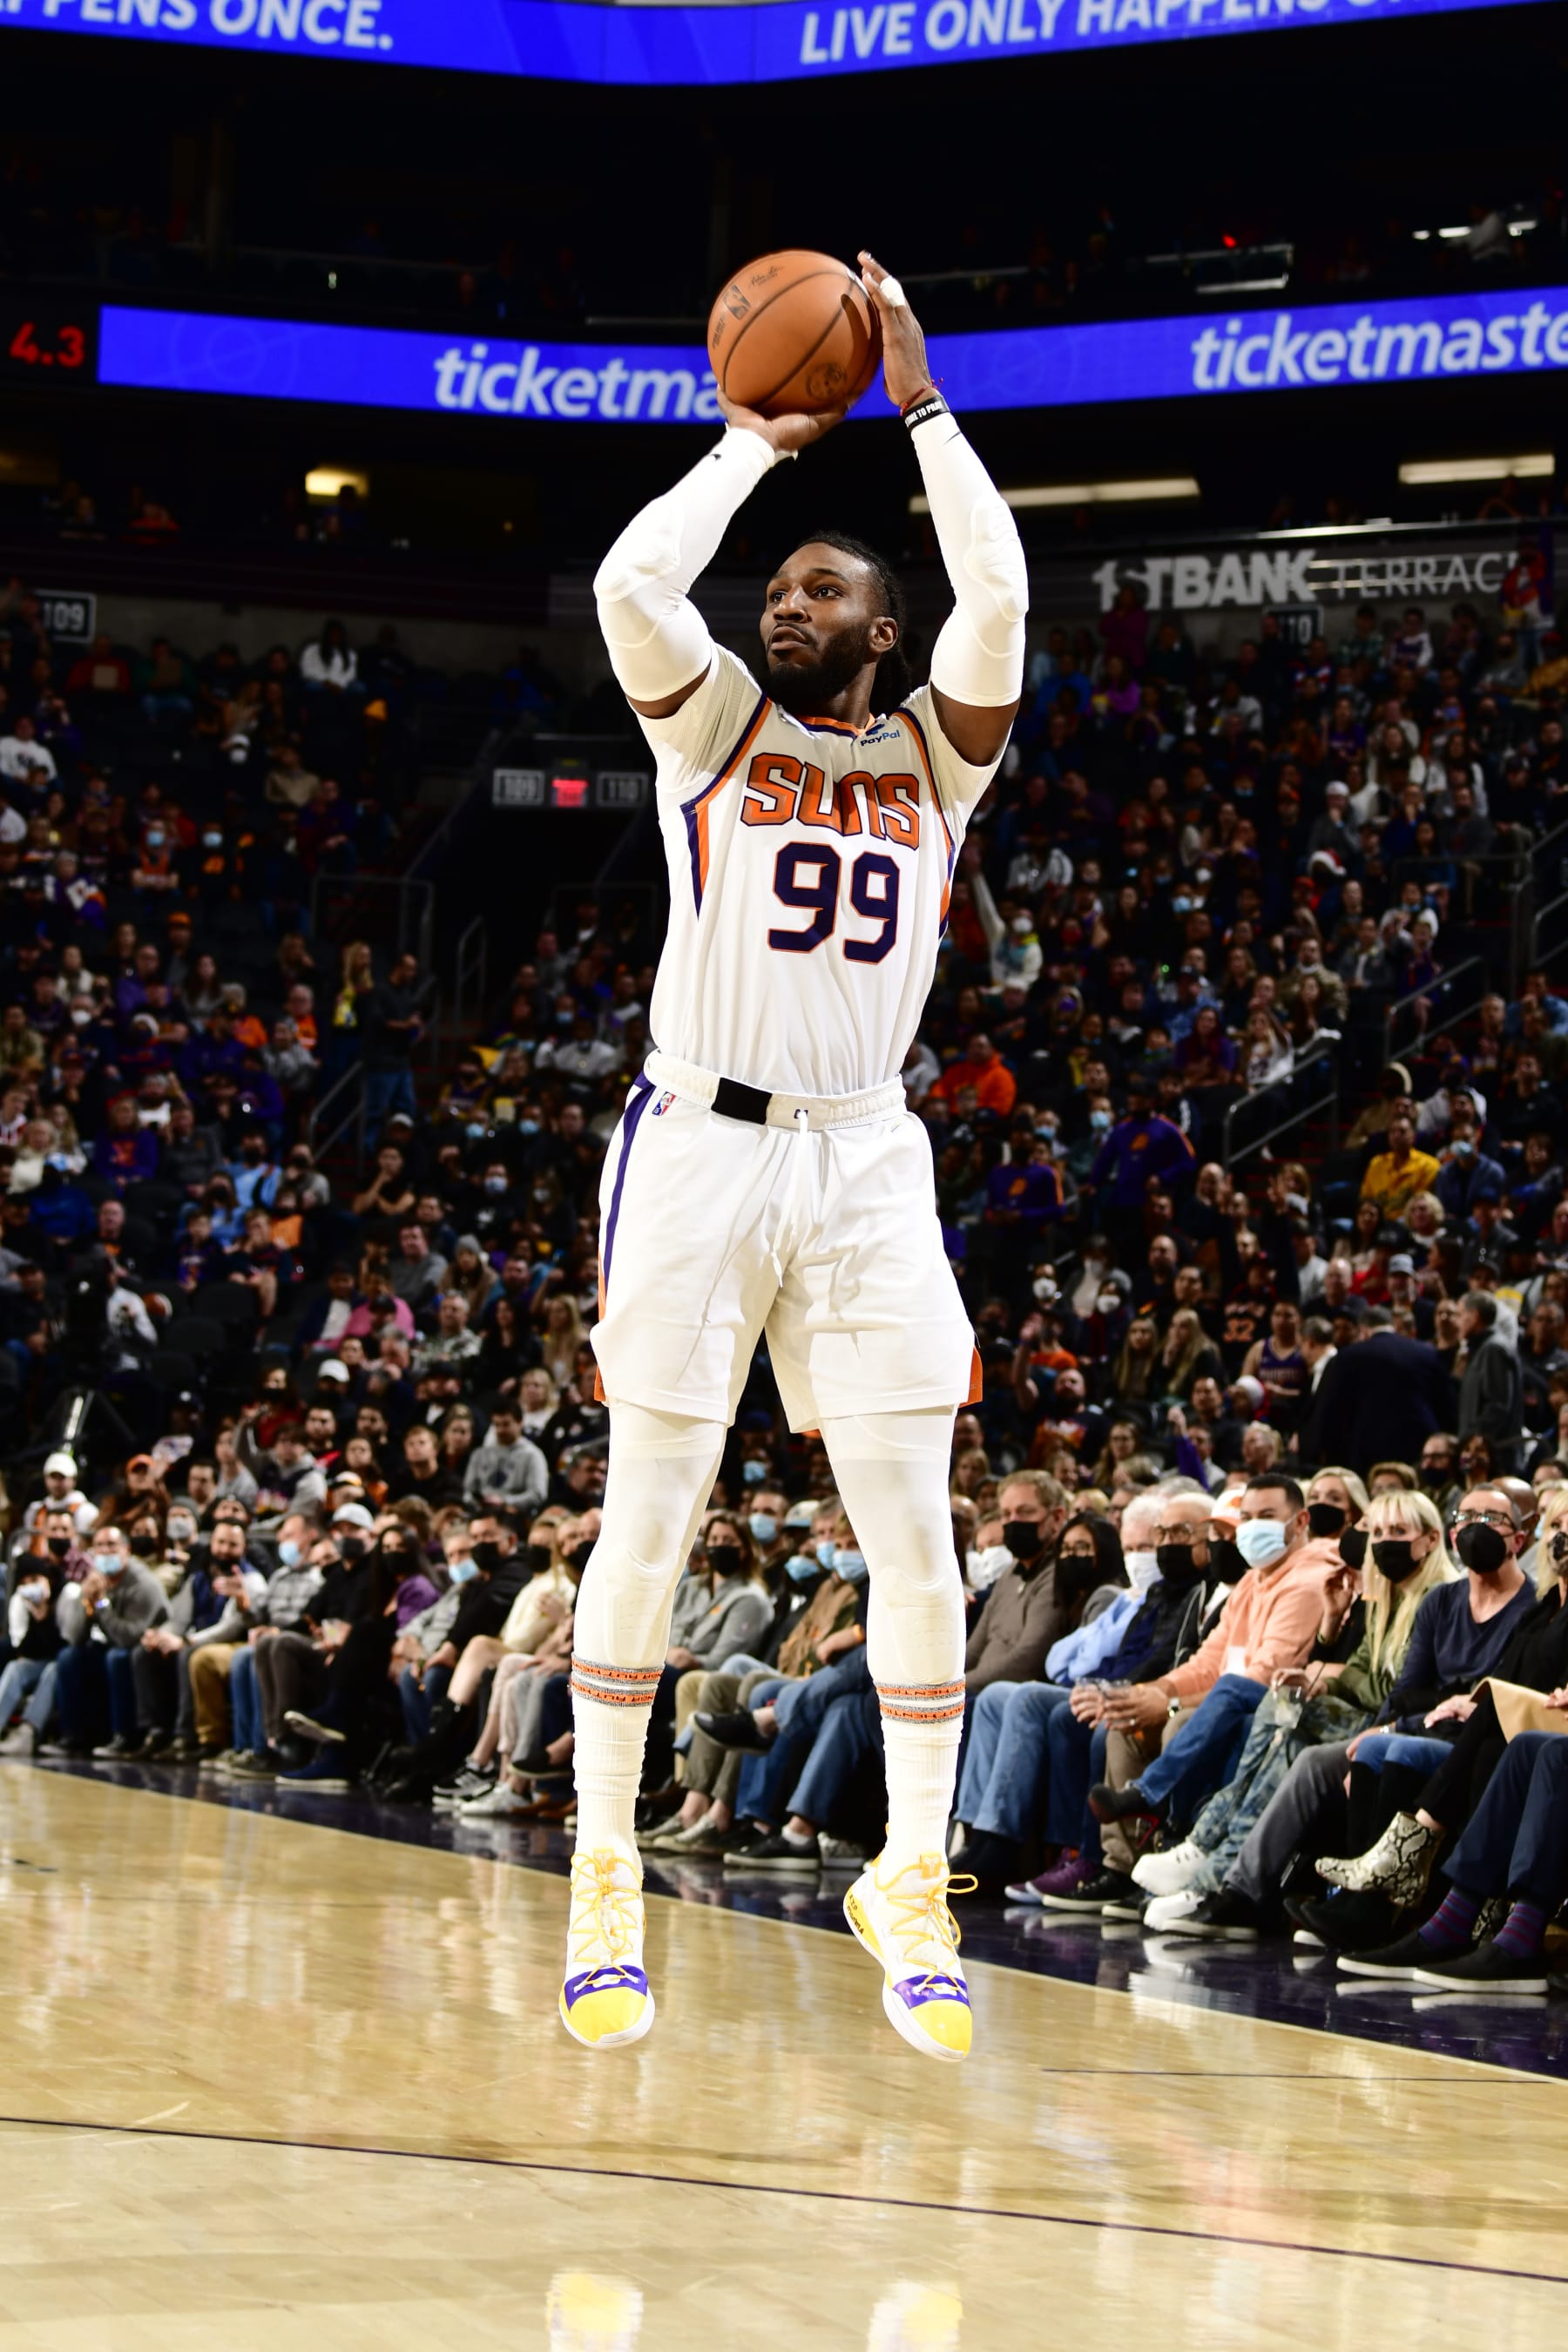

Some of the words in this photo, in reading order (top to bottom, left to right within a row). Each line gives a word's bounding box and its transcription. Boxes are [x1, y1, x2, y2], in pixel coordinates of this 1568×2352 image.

[209, 0, 394, 50] ONCE.
[799, 3, 916, 64] LIVE
[924, 0, 1071, 51] ONLY
[10, 321, 85, 367] 4.3
[1191, 301, 1568, 391] ticketmaste
[434, 343, 727, 419] ticketma
[916, 408, 927, 418] TO
[1092, 549, 1317, 613] 1TBANK
[1331, 551, 1519, 599] TERRAC
[43, 600, 84, 632] 109
[860, 729, 901, 747] PayPal
[740, 752, 920, 850] SUNS
[767, 841, 900, 965] 99
